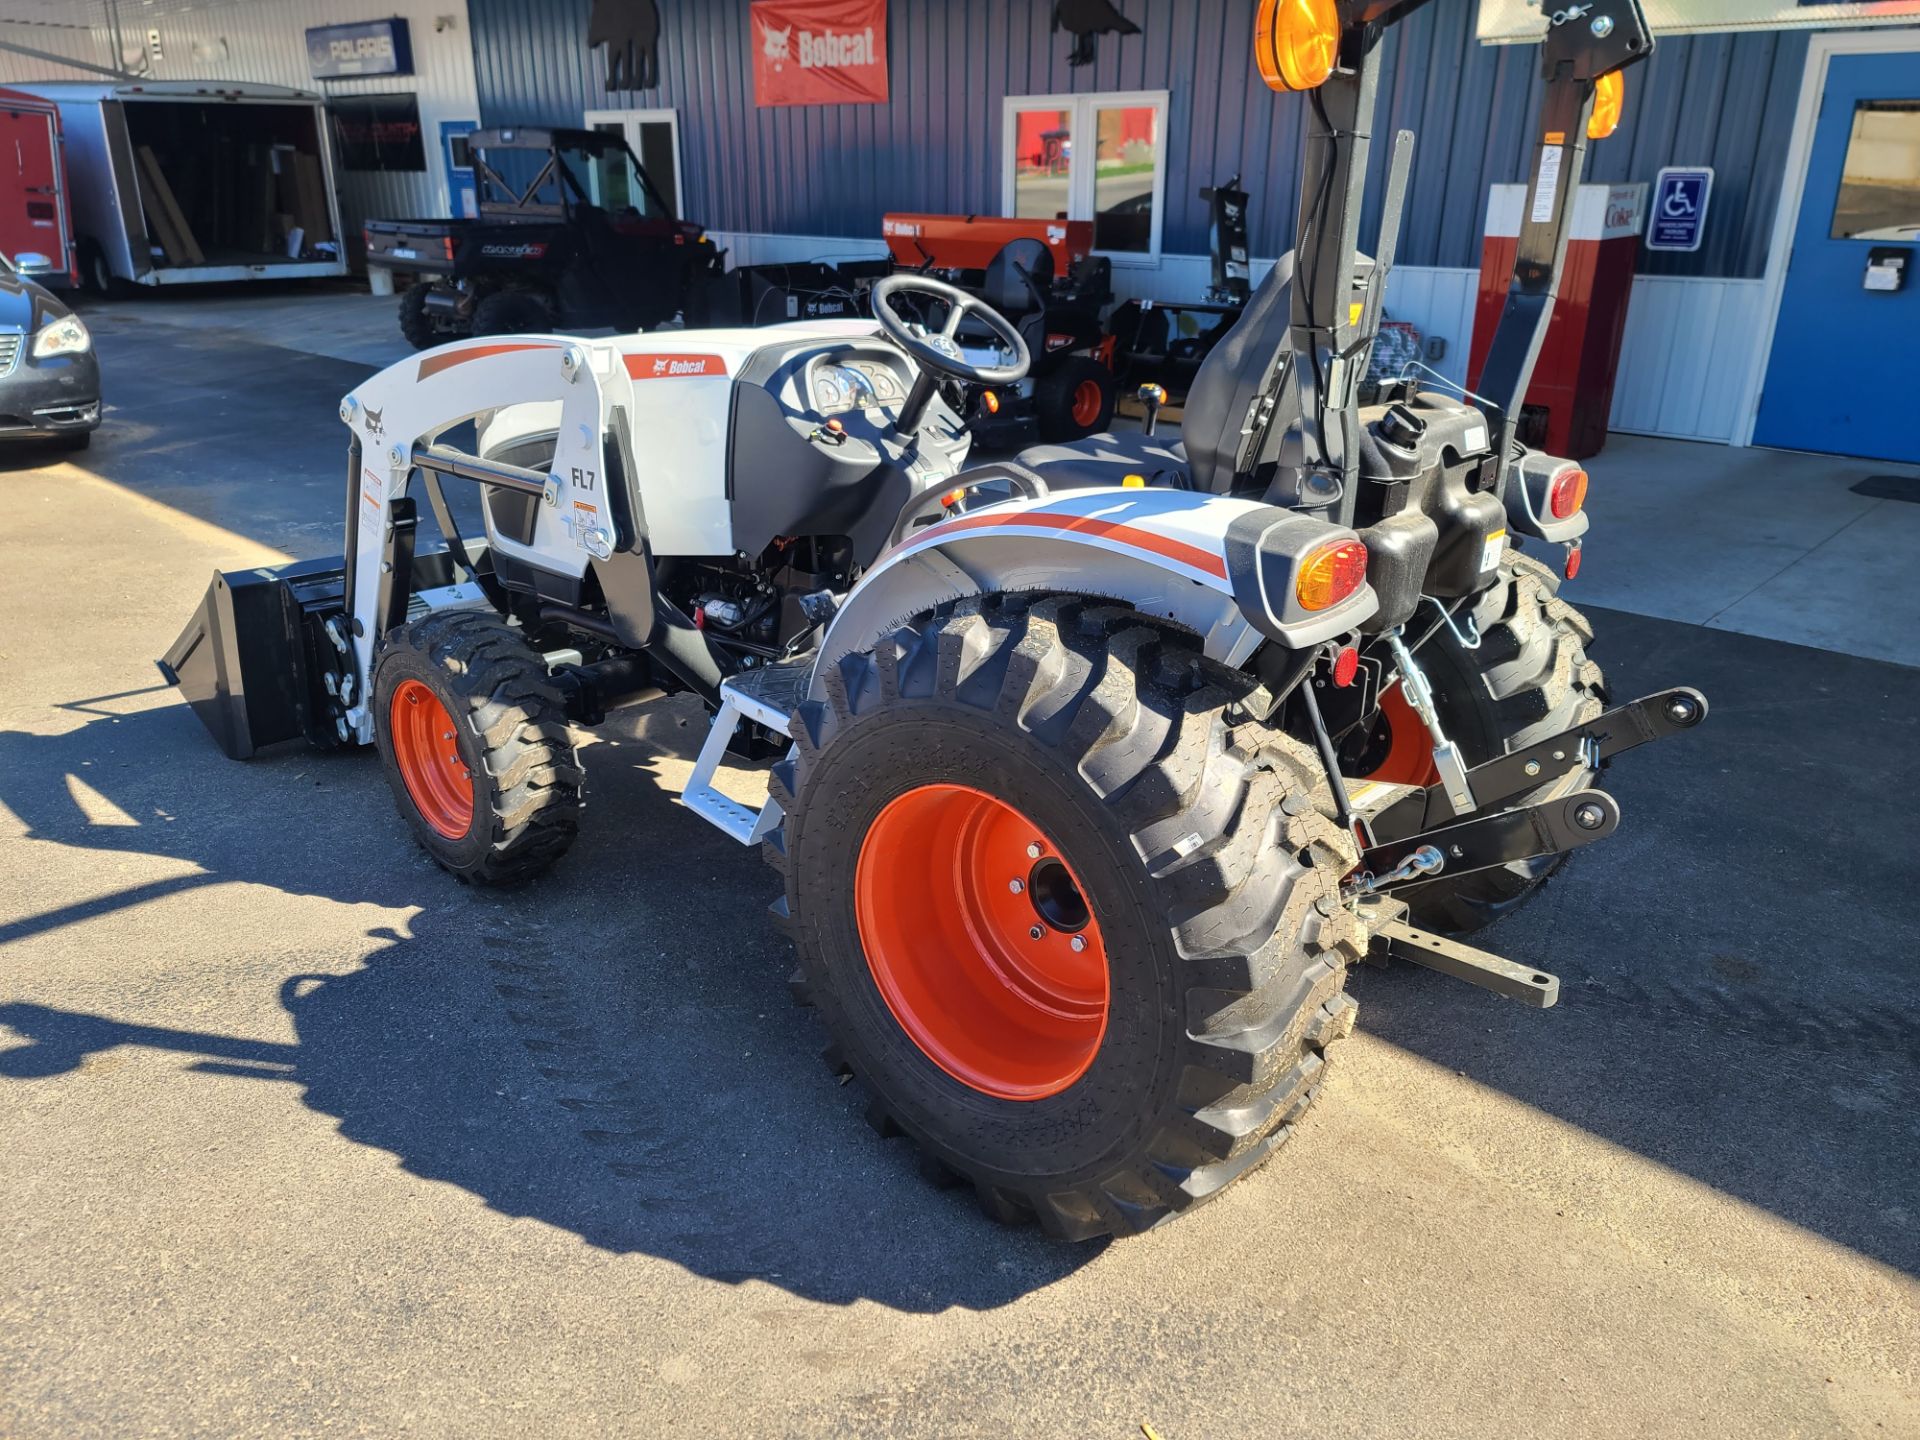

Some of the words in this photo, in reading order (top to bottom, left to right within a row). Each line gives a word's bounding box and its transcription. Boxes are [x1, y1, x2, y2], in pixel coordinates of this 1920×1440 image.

[330, 36, 391, 60] POLARIS
[798, 27, 874, 68] Bobcat
[819, 301, 844, 314] Bobcat
[669, 360, 706, 374] Bobcat
[571, 466, 595, 491] FL7
